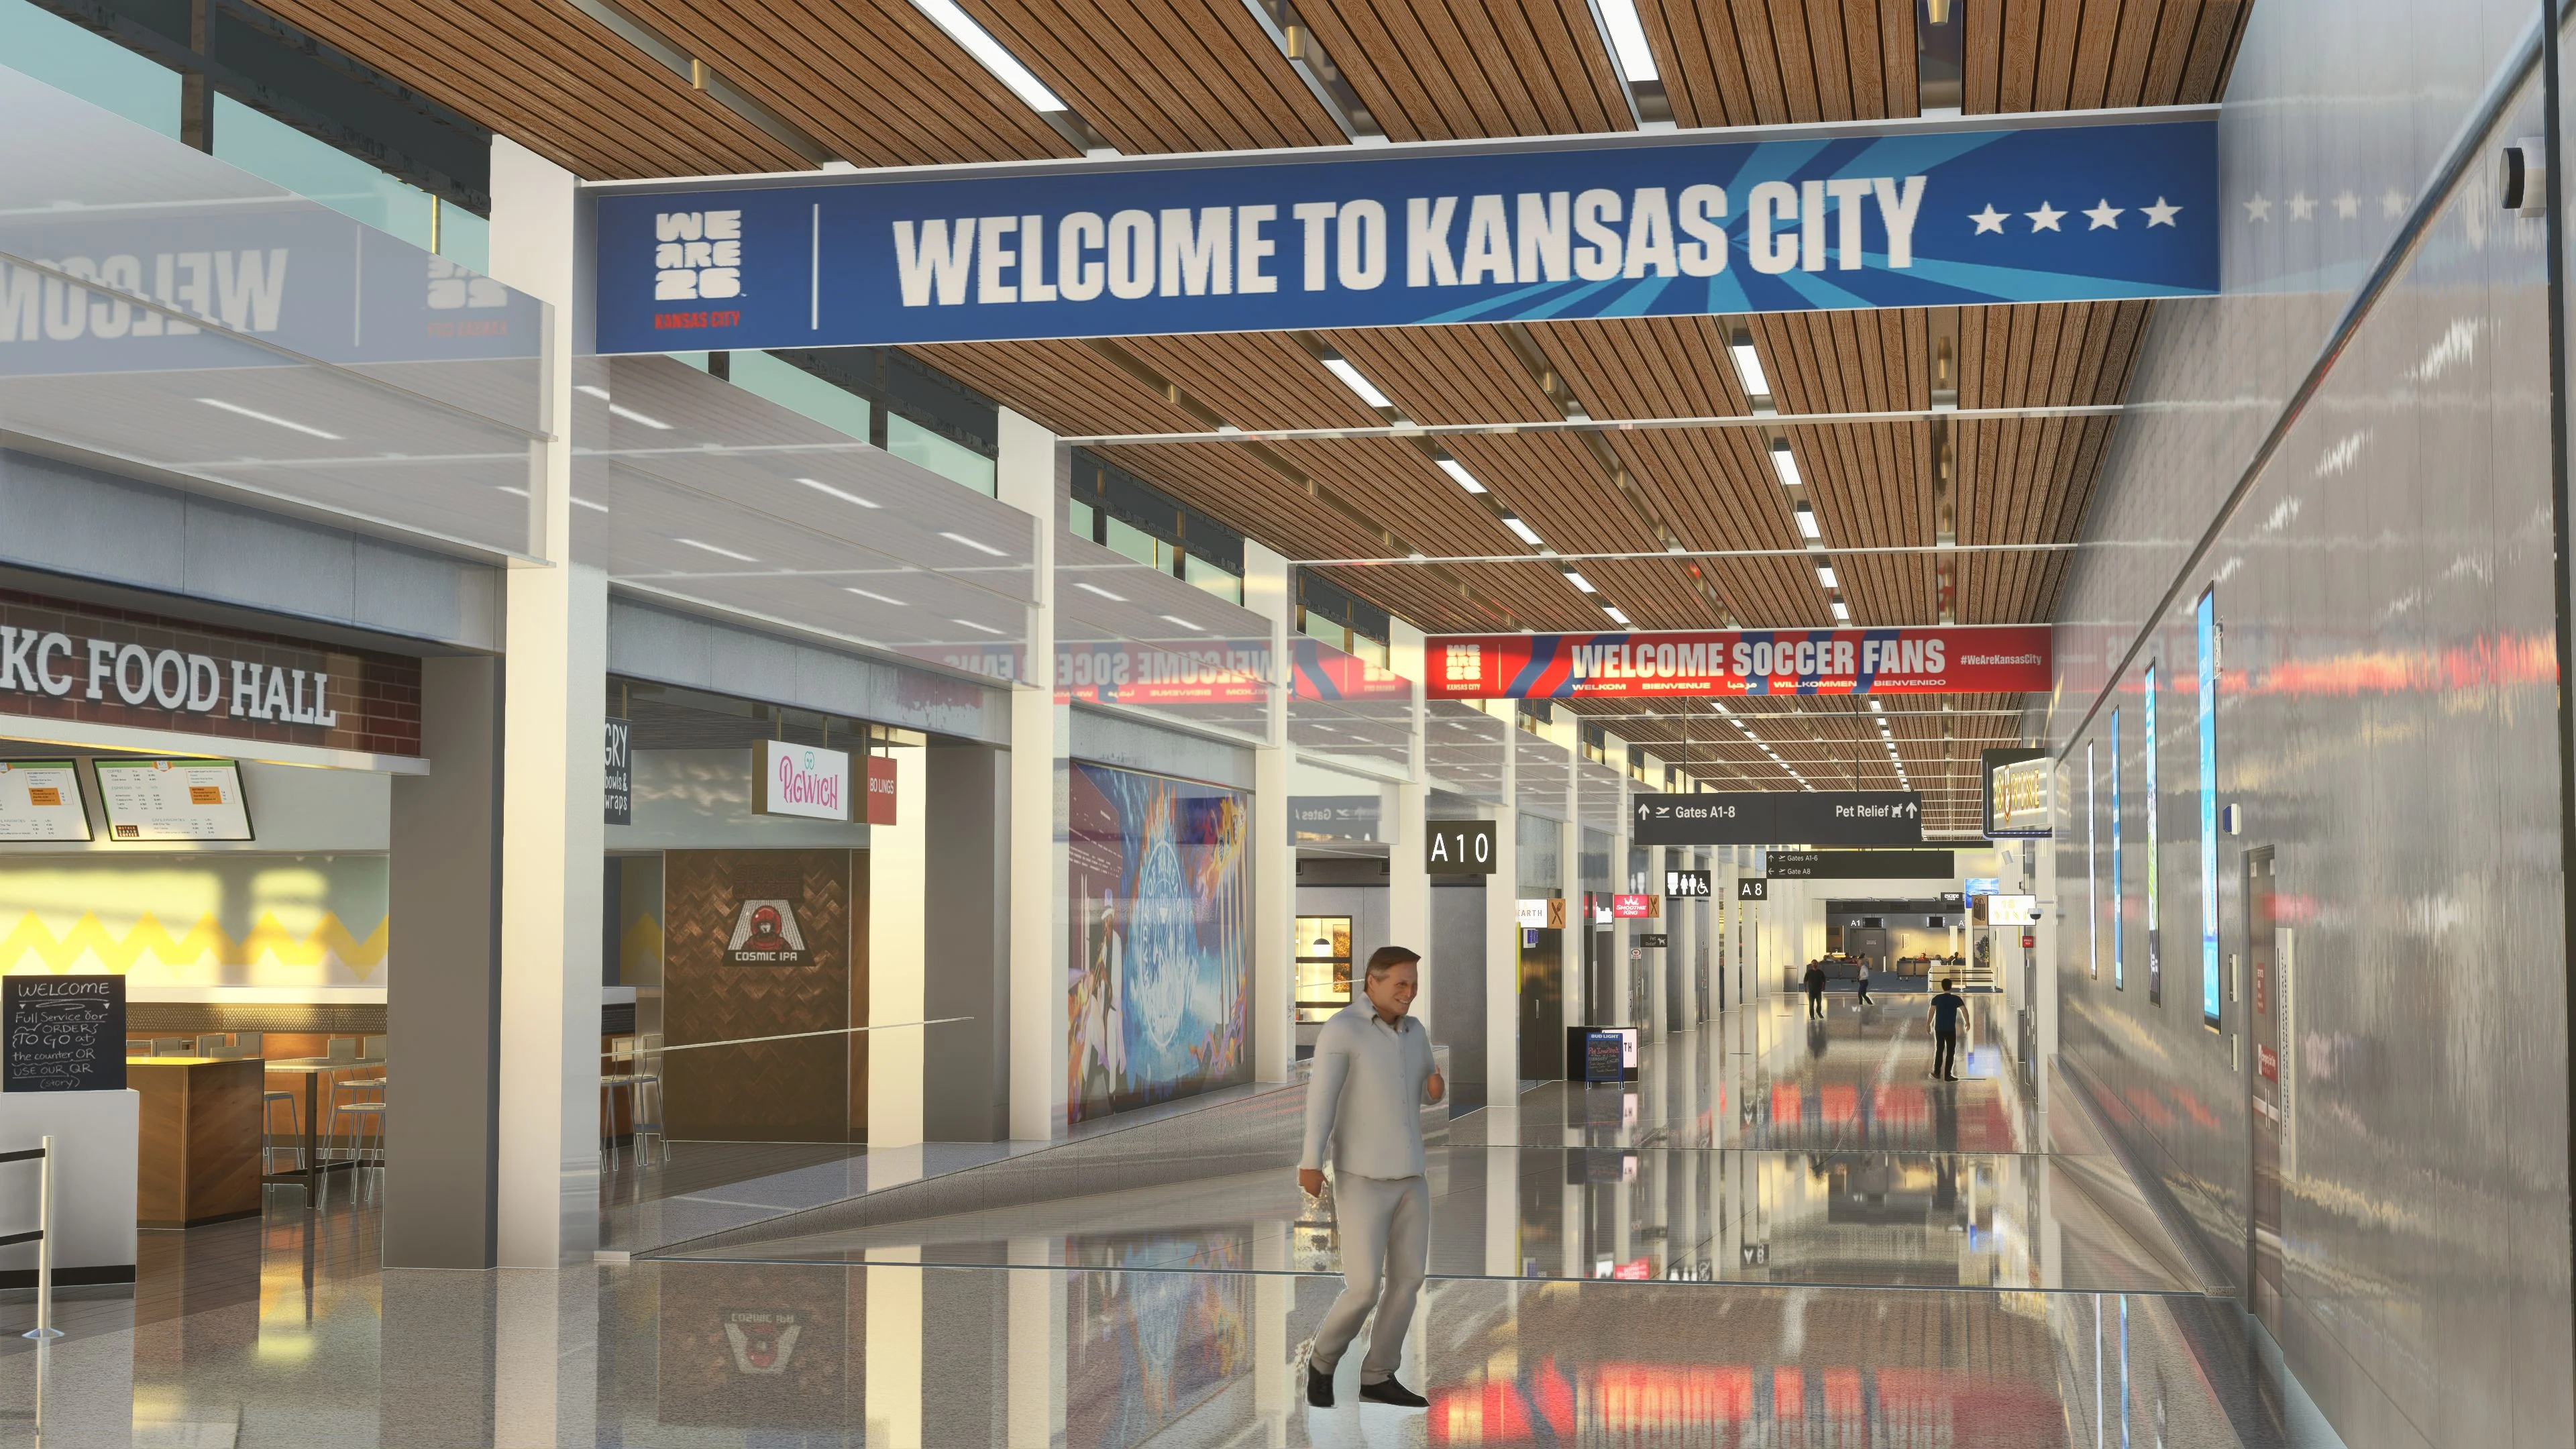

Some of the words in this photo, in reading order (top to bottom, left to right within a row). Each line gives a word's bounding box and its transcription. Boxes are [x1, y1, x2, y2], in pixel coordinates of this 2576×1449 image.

[656, 210, 741, 242] WE
[893, 204, 1277, 307] WELCOME
[1293, 199, 1387, 292] TO
[1407, 183, 1729, 287] KANSAS
[1747, 175, 1928, 276] CITY
[655, 267, 741, 301] 26
[655, 311, 708, 329] KANSAS
[710, 310, 741, 328] CITY
[1571, 642, 1724, 678] WELCOME
[1732, 641, 1854, 677] SOCCER
[1863, 639, 1945, 675] FANS
[1960, 653, 2042, 665] #WeAreKansasCity
[0, 625, 72, 696] KC
[86, 639, 220, 712] FOOD
[231, 659, 336, 727] HALL
[1727, 681, 1758, 690] مرحبا
[870, 777, 877, 792] BO
[878, 778, 894, 794] LINGS
[604, 794, 627, 815] wraps
[1835, 806, 1855, 818] Pet
[1857, 805, 1889, 817] Relief
[1675, 806, 1707, 818] Gates
[1710, 806, 1735, 818] A1-8
[735, 952, 776, 961] COSMIC
[780, 952, 798, 961] IPA
[15, 1012, 38, 1023] Full
[40, 1012, 80, 1022] Service
[42, 1024, 99, 1034] ORDERS
[44, 1034, 70, 1049] GO
[13, 1051, 32, 1061] the
[34, 1051, 74, 1060] counter
[76, 1048, 96, 1059] OR
[13, 1067, 37, 1076] USE
[40, 1065, 69, 1077] OUR
[70, 1063, 94, 1073] QR
